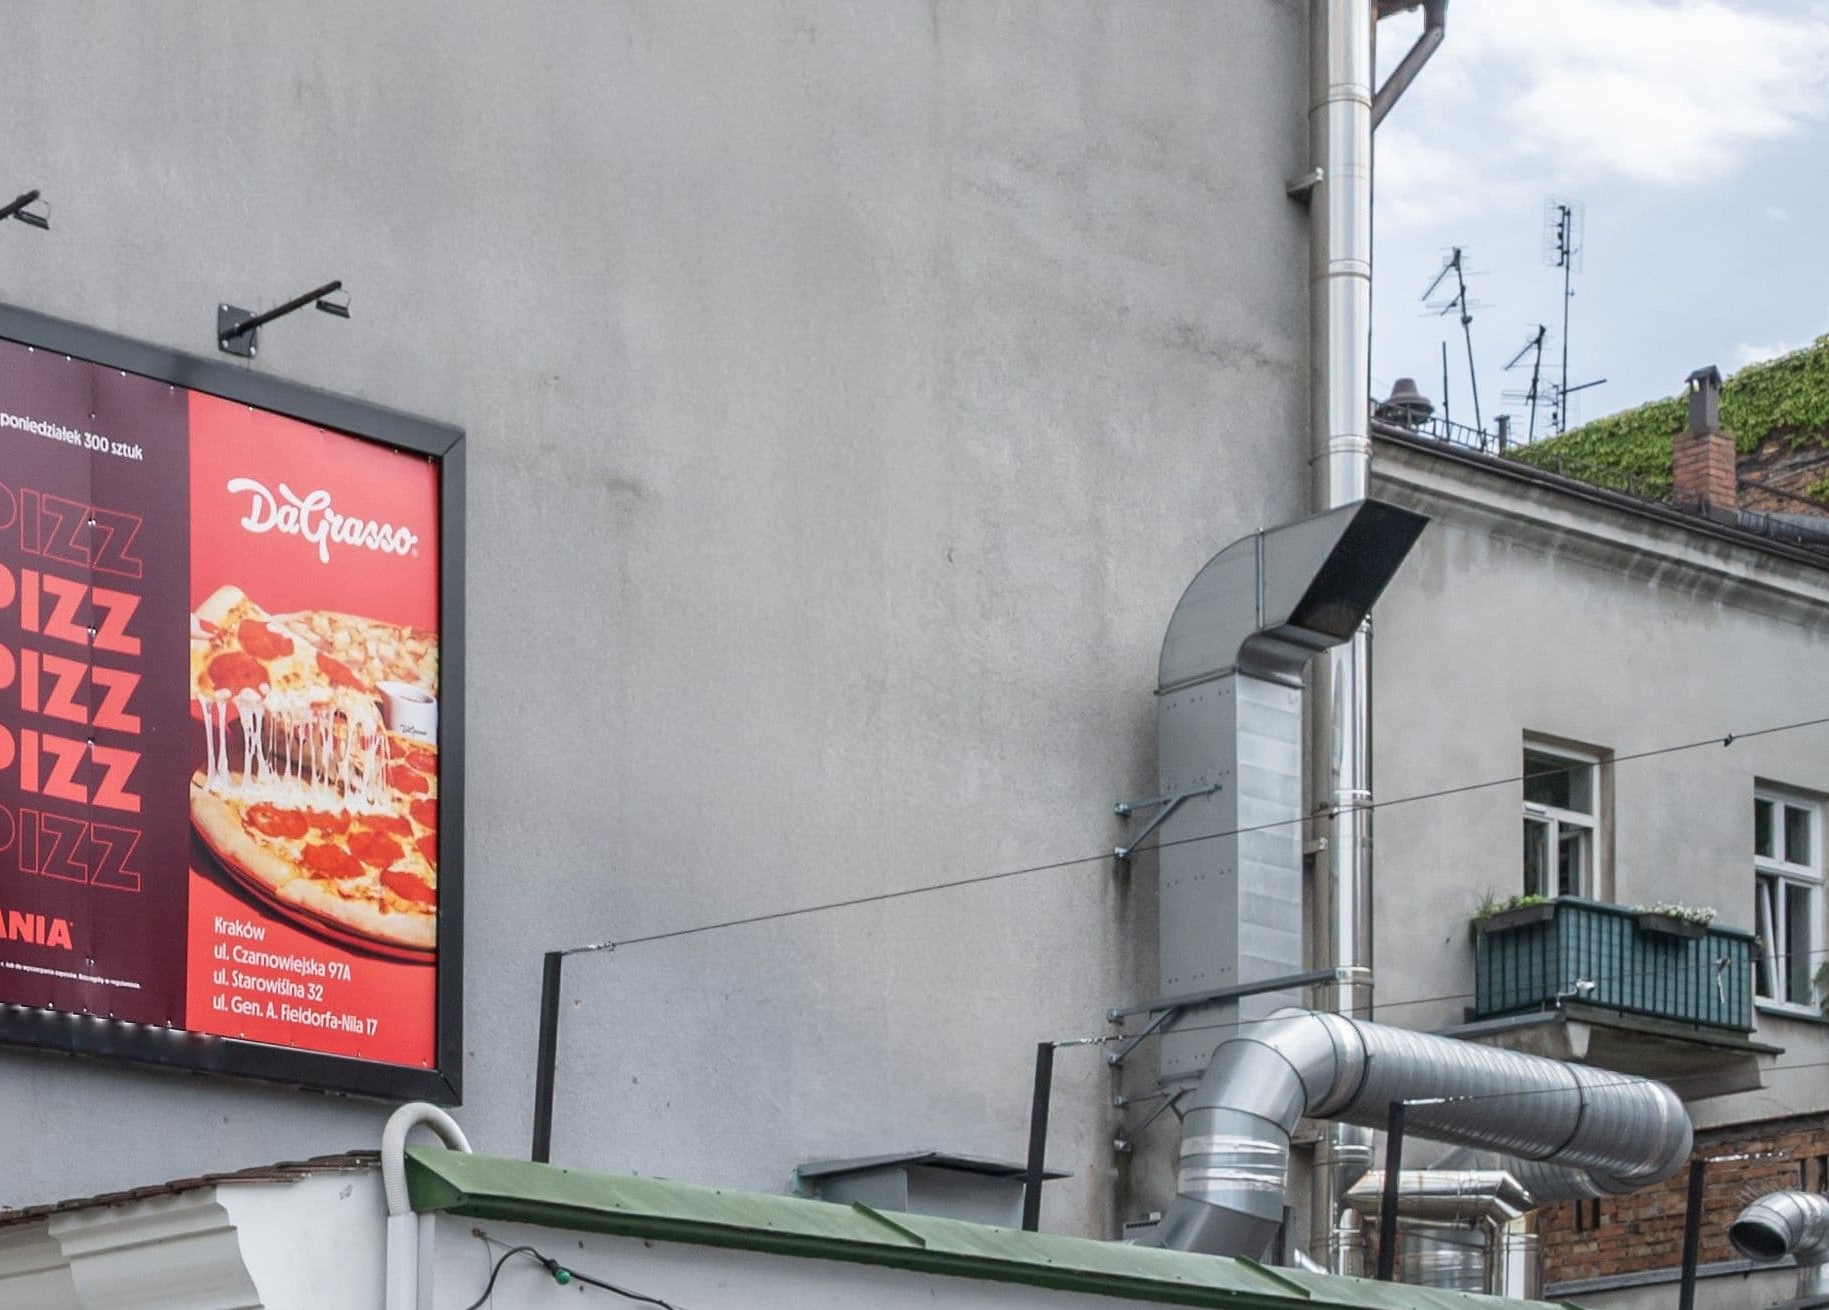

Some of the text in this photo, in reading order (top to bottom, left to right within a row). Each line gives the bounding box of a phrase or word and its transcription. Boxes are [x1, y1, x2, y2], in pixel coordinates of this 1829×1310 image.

[0, 411, 82, 447] poniedziałek
[83, 431, 109, 453] 300
[111, 441, 144, 461] sztuk
[214, 917, 266, 941] Kraków
[214, 944, 351, 981] ul. Czarnowiejska 97A
[213, 970, 324, 1001] ul. Starowiślna 32
[213, 995, 378, 1036] ul. Gen. A. Fieldorfa-Nila 17
